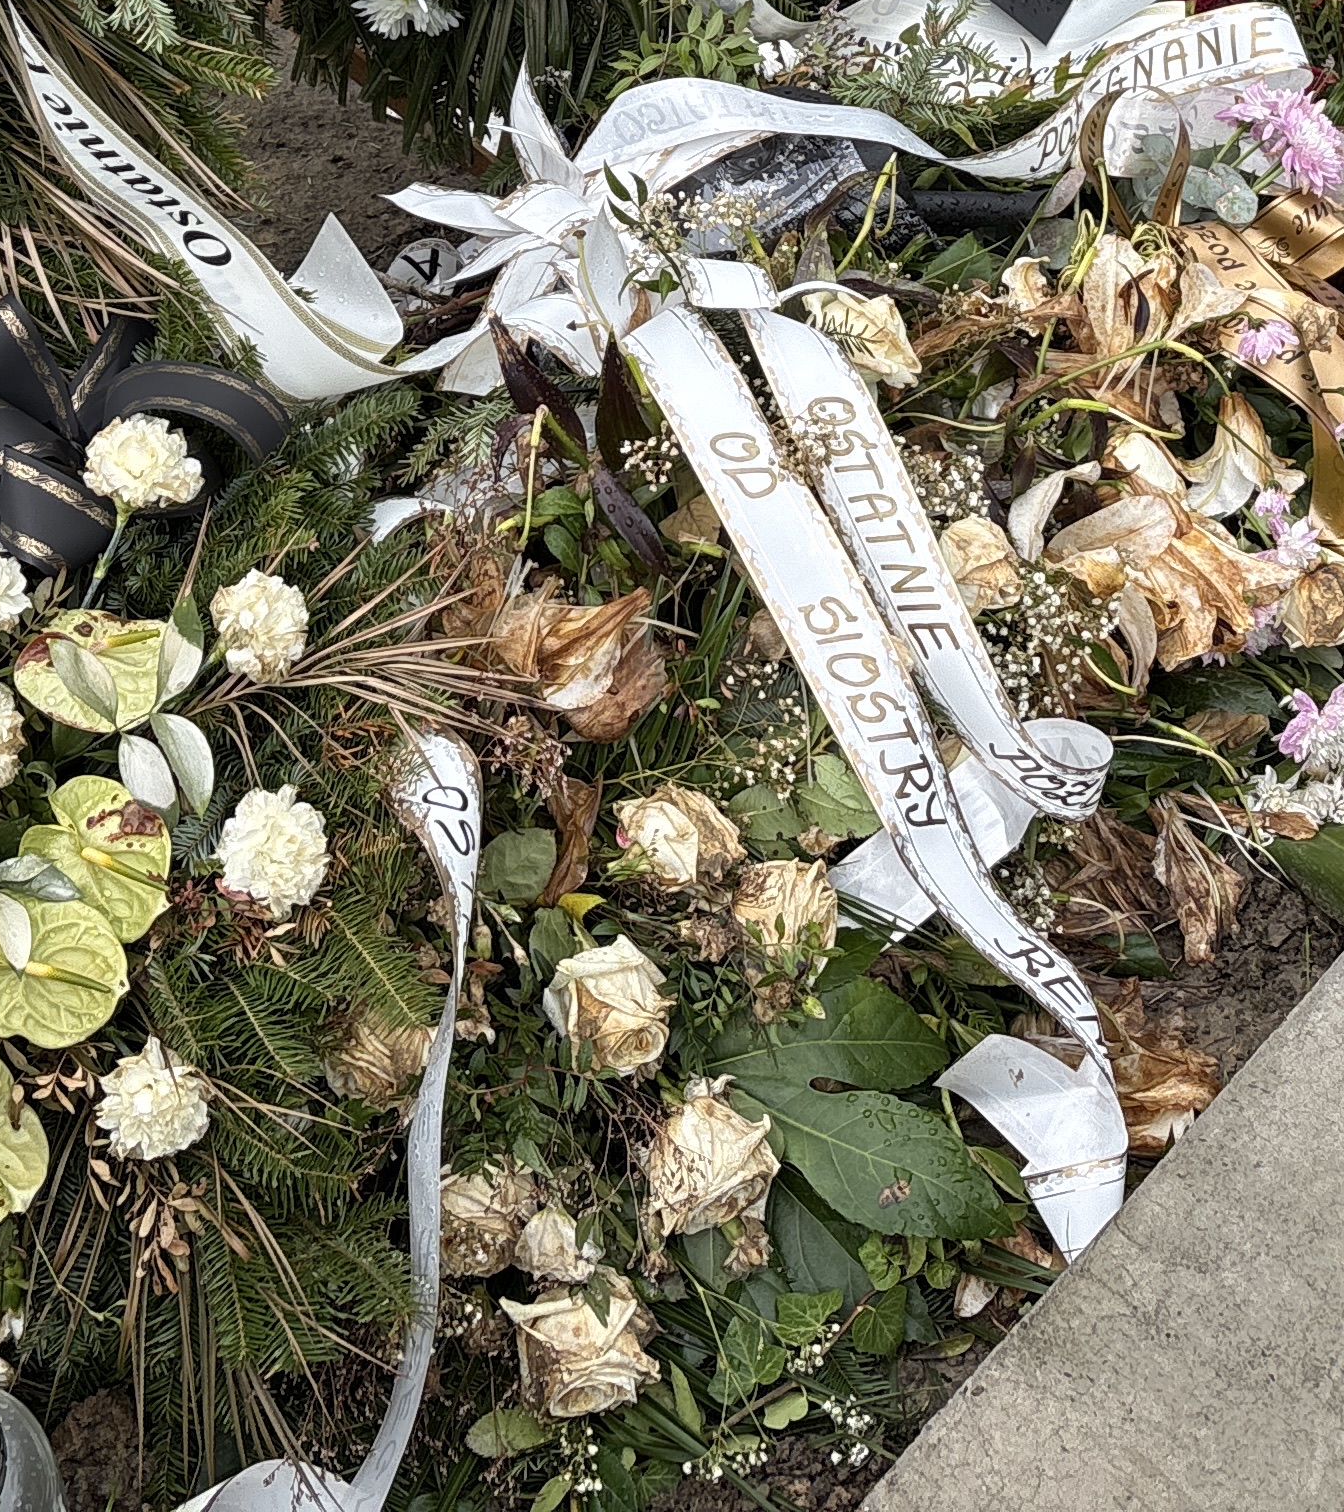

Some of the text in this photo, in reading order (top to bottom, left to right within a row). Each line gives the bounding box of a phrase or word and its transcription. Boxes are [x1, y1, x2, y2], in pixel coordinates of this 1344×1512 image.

[41, 91, 232, 266] Ostatnie
[709, 432, 778, 499] OD
[808, 396, 960, 660] OSTATNIE
[798, 595, 948, 828] SIOSTRY
